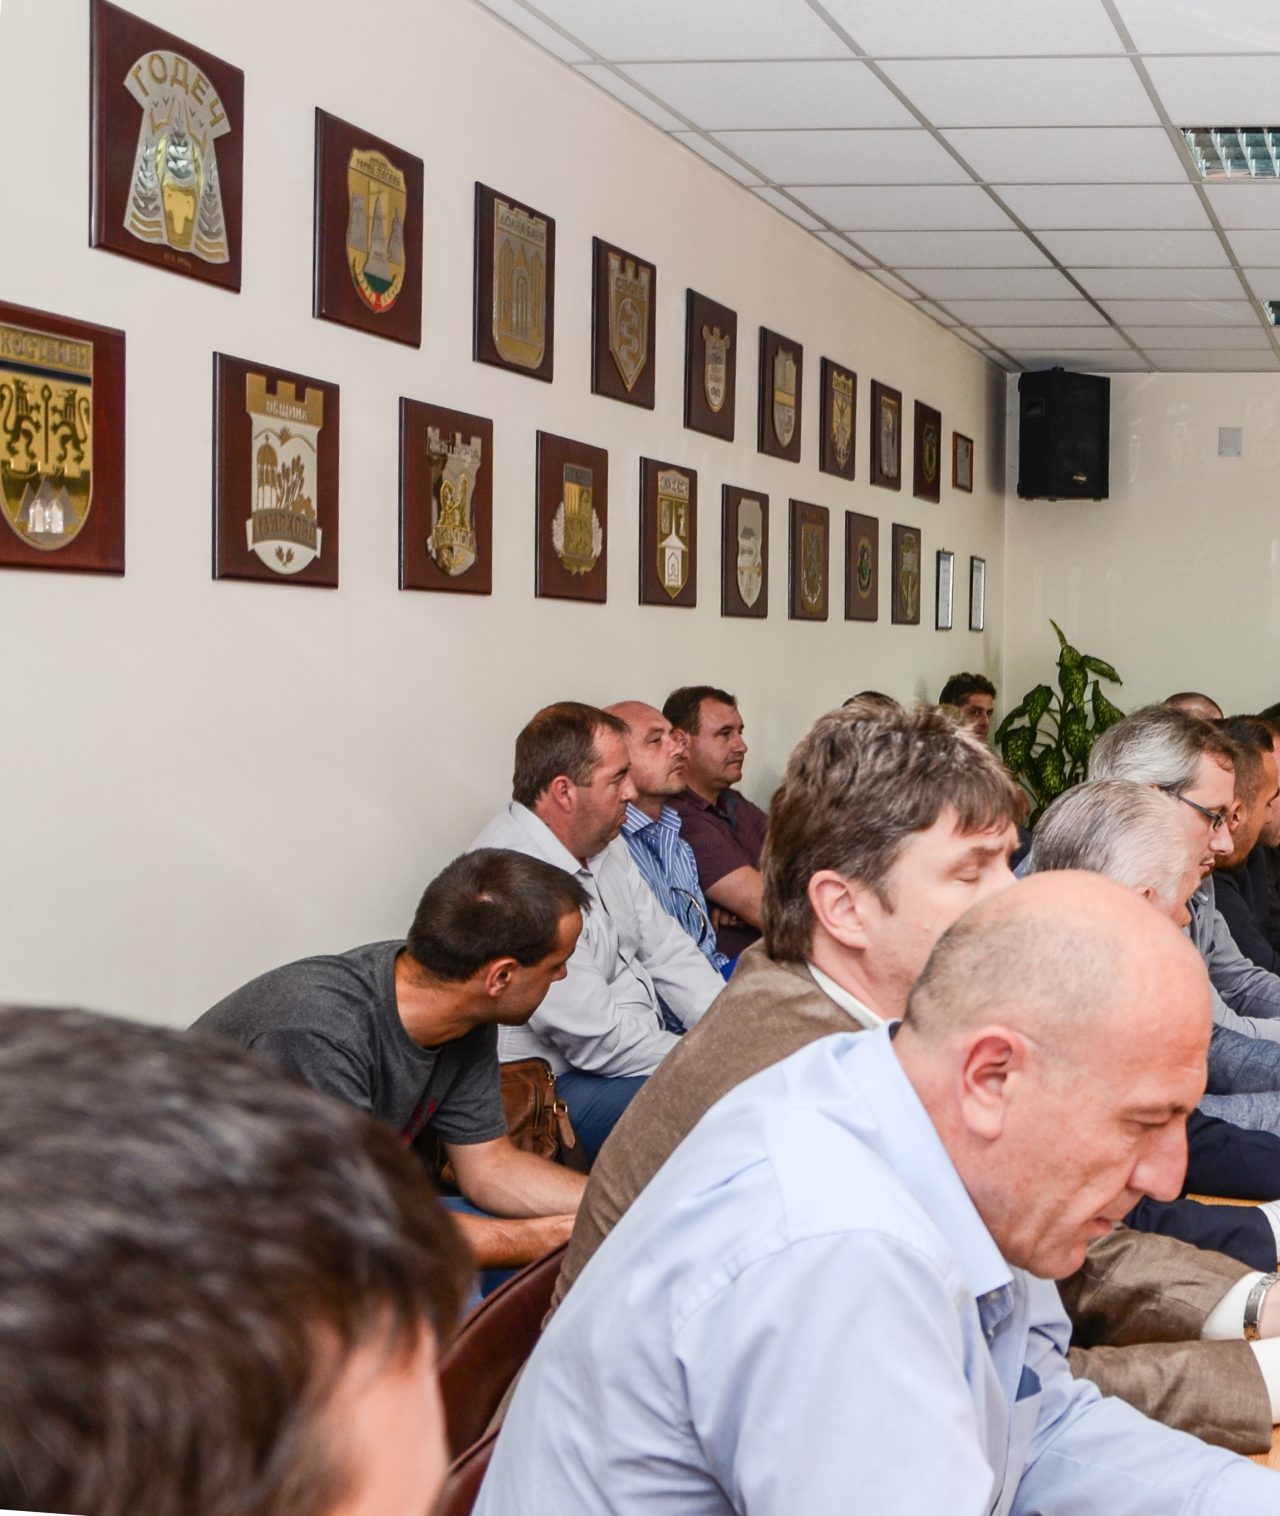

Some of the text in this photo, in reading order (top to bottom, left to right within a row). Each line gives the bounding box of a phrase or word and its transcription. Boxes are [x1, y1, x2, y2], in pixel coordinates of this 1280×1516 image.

[131, 53, 225, 128] ГОДЕЧ
[0, 330, 90, 370] КОСТЕНЕЦ
[265, 400, 307, 421] ОБЩИНА
